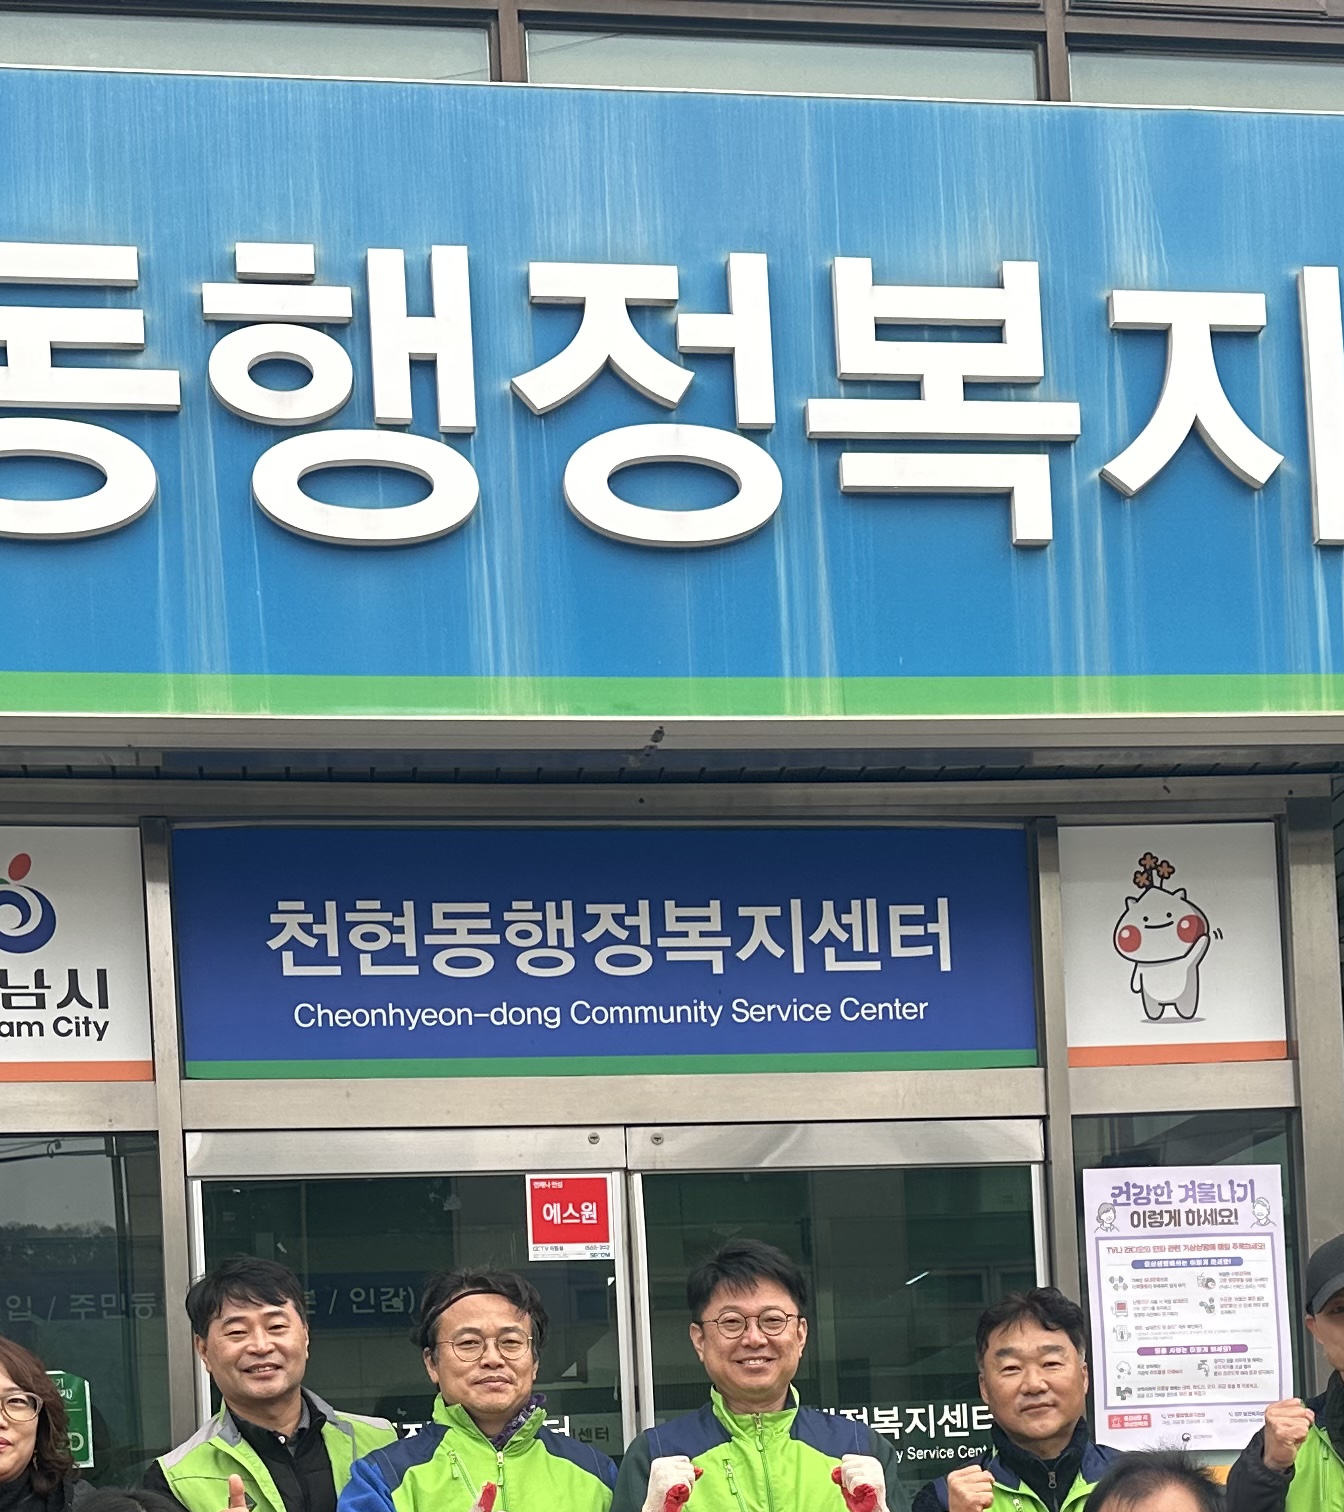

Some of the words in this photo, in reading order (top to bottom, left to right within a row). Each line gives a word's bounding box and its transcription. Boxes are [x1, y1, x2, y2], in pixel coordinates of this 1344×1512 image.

[267, 895, 953, 979] 천현동행정복지센터
[292, 999, 563, 1035] Cheonhyeon-dong
[569, 997, 722, 1031] Community
[730, 995, 832, 1026] Service
[840, 994, 929, 1024] Center
[52, 1015, 110, 1042] City
[1111, 1180, 1173, 1207] 건강한
[1178, 1179, 1256, 1206] 겨울나기
[543, 1202, 597, 1224] 에스원
[1130, 1208, 1182, 1229] 이렇게
[1186, 1208, 1238, 1228] 하세요!
[907, 1445, 955, 1460] Service
[958, 1444, 988, 1460] Cent
